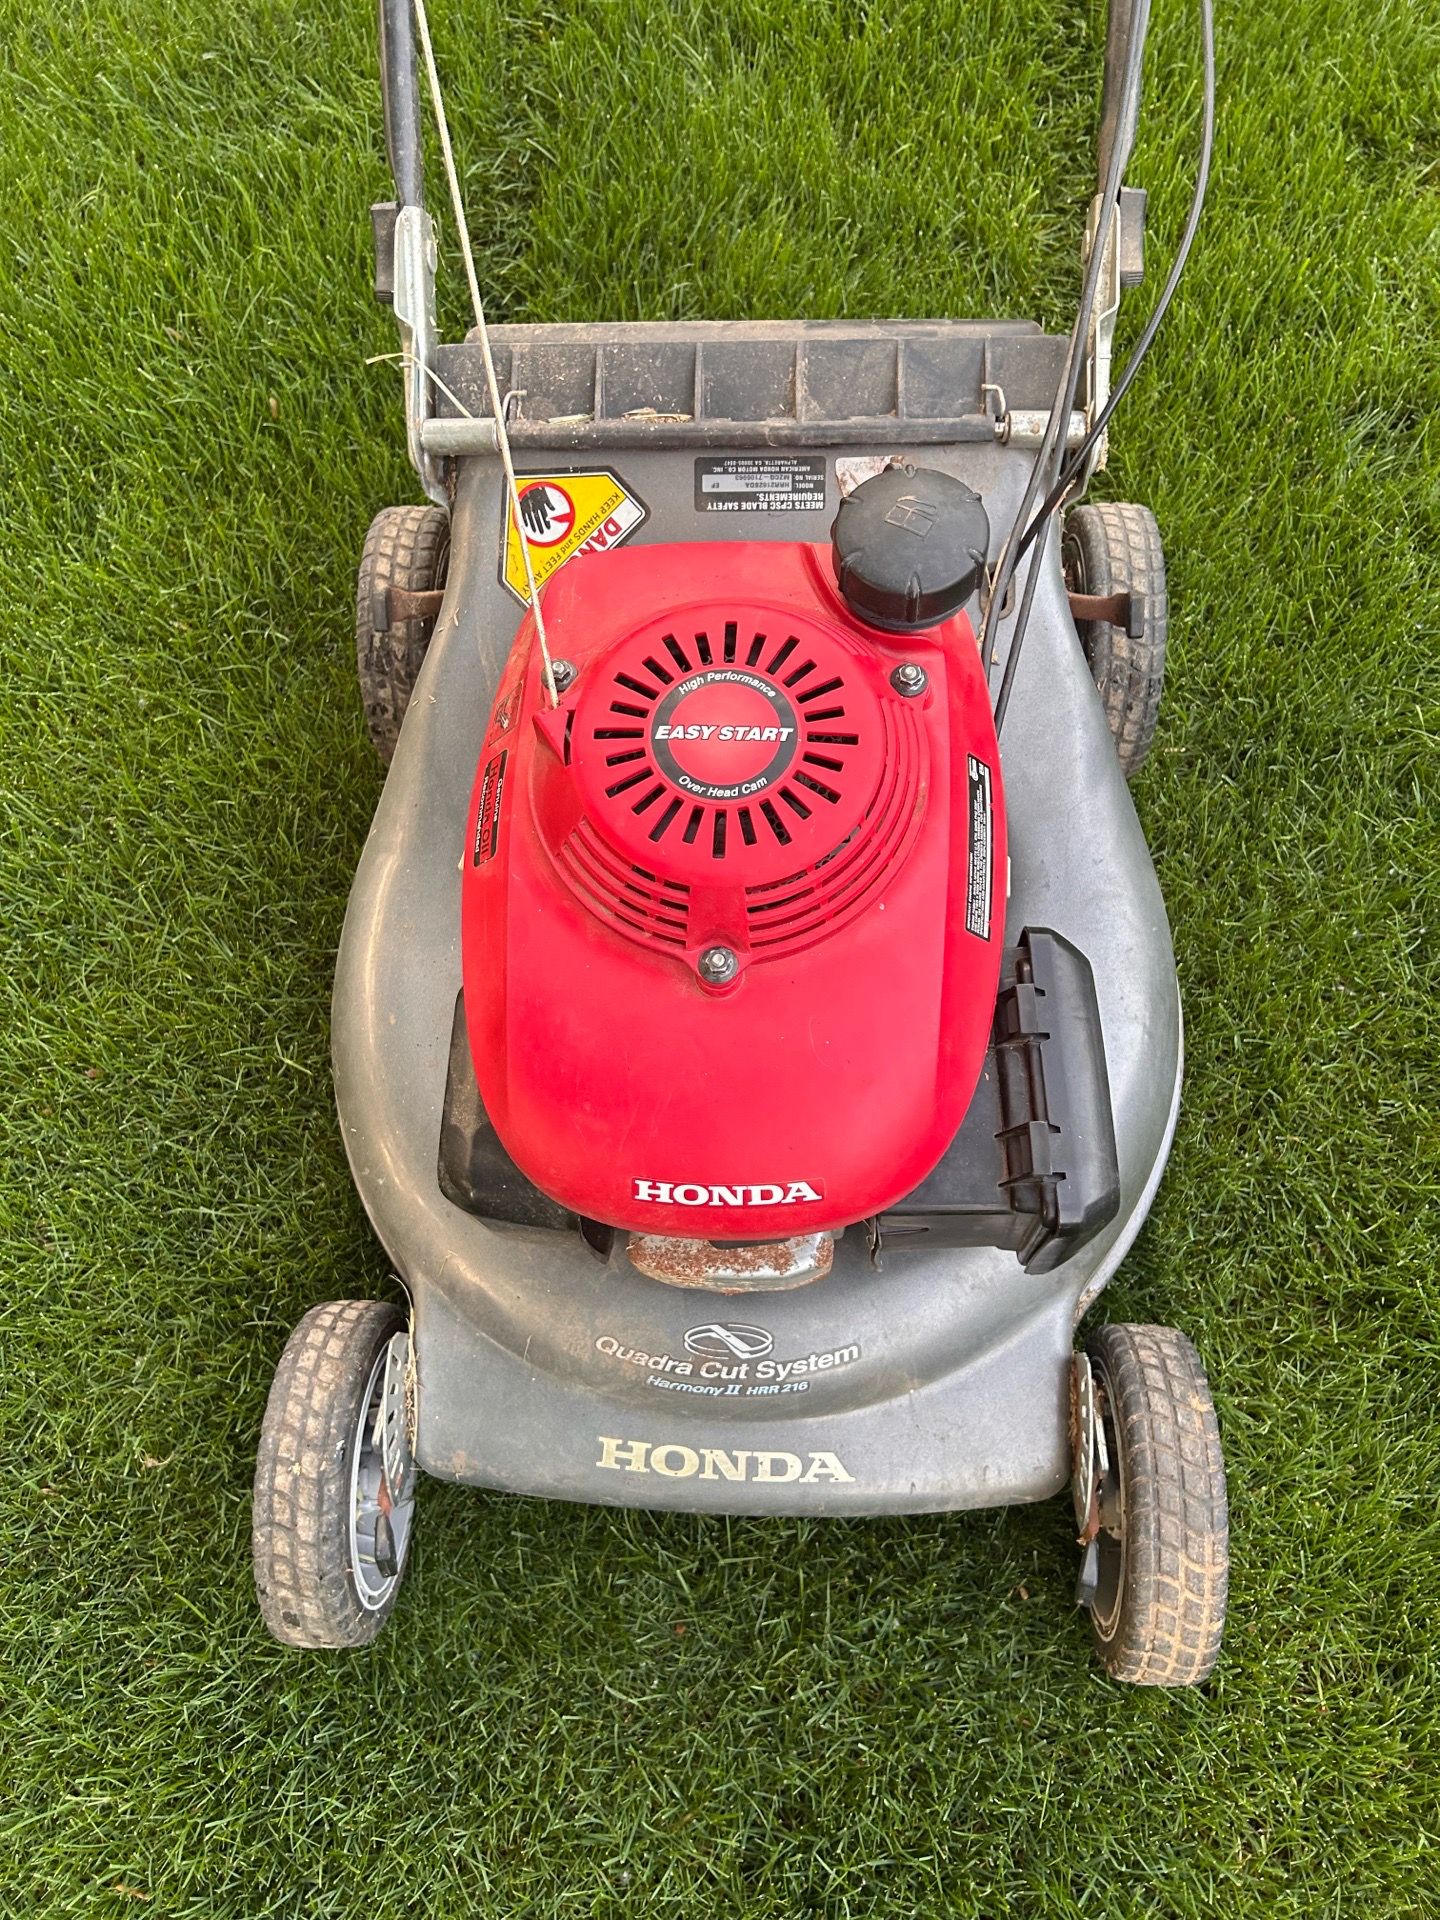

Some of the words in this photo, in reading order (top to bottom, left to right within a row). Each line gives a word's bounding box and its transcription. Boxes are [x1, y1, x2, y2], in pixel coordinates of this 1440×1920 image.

[600, 492, 620, 514] KEEP
[707, 502, 738, 510] SAFETY
[741, 502, 767, 510] BLADE
[757, 493, 823, 501] REQUIREMENTS.
[770, 502, 792, 510] CPSC
[795, 501, 823, 509] MEETS
[573, 512, 600, 541] HANDS
[560, 539, 572, 553] and
[542, 552, 560, 573] FEET
[679, 676, 704, 695] High
[707, 671, 776, 697] Performance
[655, 725, 717, 740] EASY
[718, 726, 794, 741] START
[483, 764, 499, 824] Honda
[679, 775, 706, 794] Over
[707, 787, 739, 797] Head
[742, 777, 767, 794] Cam
[493, 778, 503, 822] Genuine
[481, 829, 490, 854] Oil
[635, 1180, 822, 1206] HONDA
[595, 1335, 692, 1376] Quadra
[700, 1360, 750, 1380] Cut
[755, 1345, 859, 1381] System
[647, 1375, 724, 1396] Harmony
[746, 1385, 779, 1395] HRR
[782, 1381, 808, 1392] 216
[596, 1436, 855, 1483] HONDA
